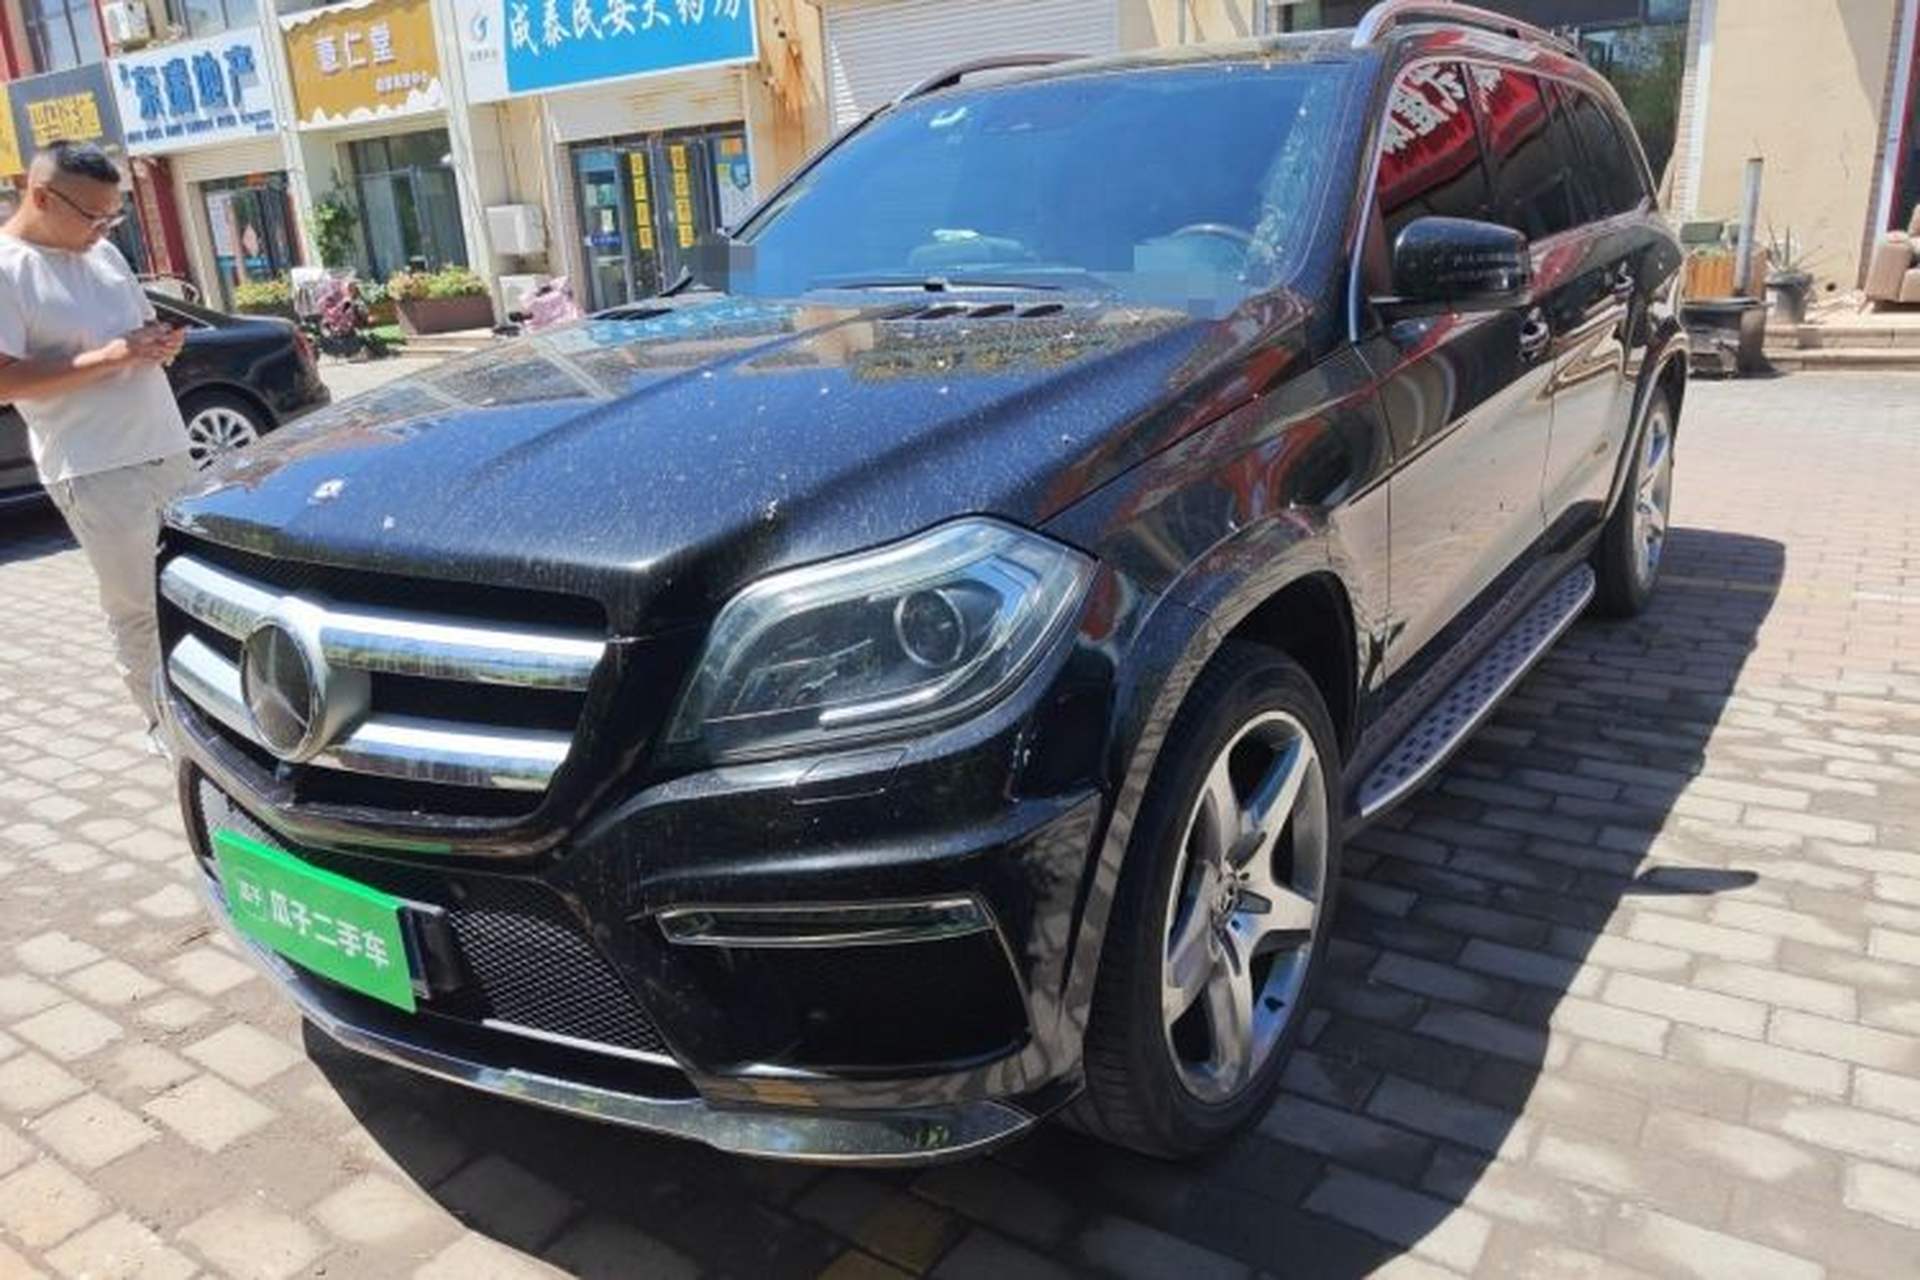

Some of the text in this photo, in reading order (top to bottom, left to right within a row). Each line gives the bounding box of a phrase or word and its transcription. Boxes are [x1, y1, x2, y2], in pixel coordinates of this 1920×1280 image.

[270, 889, 390, 968] 瓜子二手车
